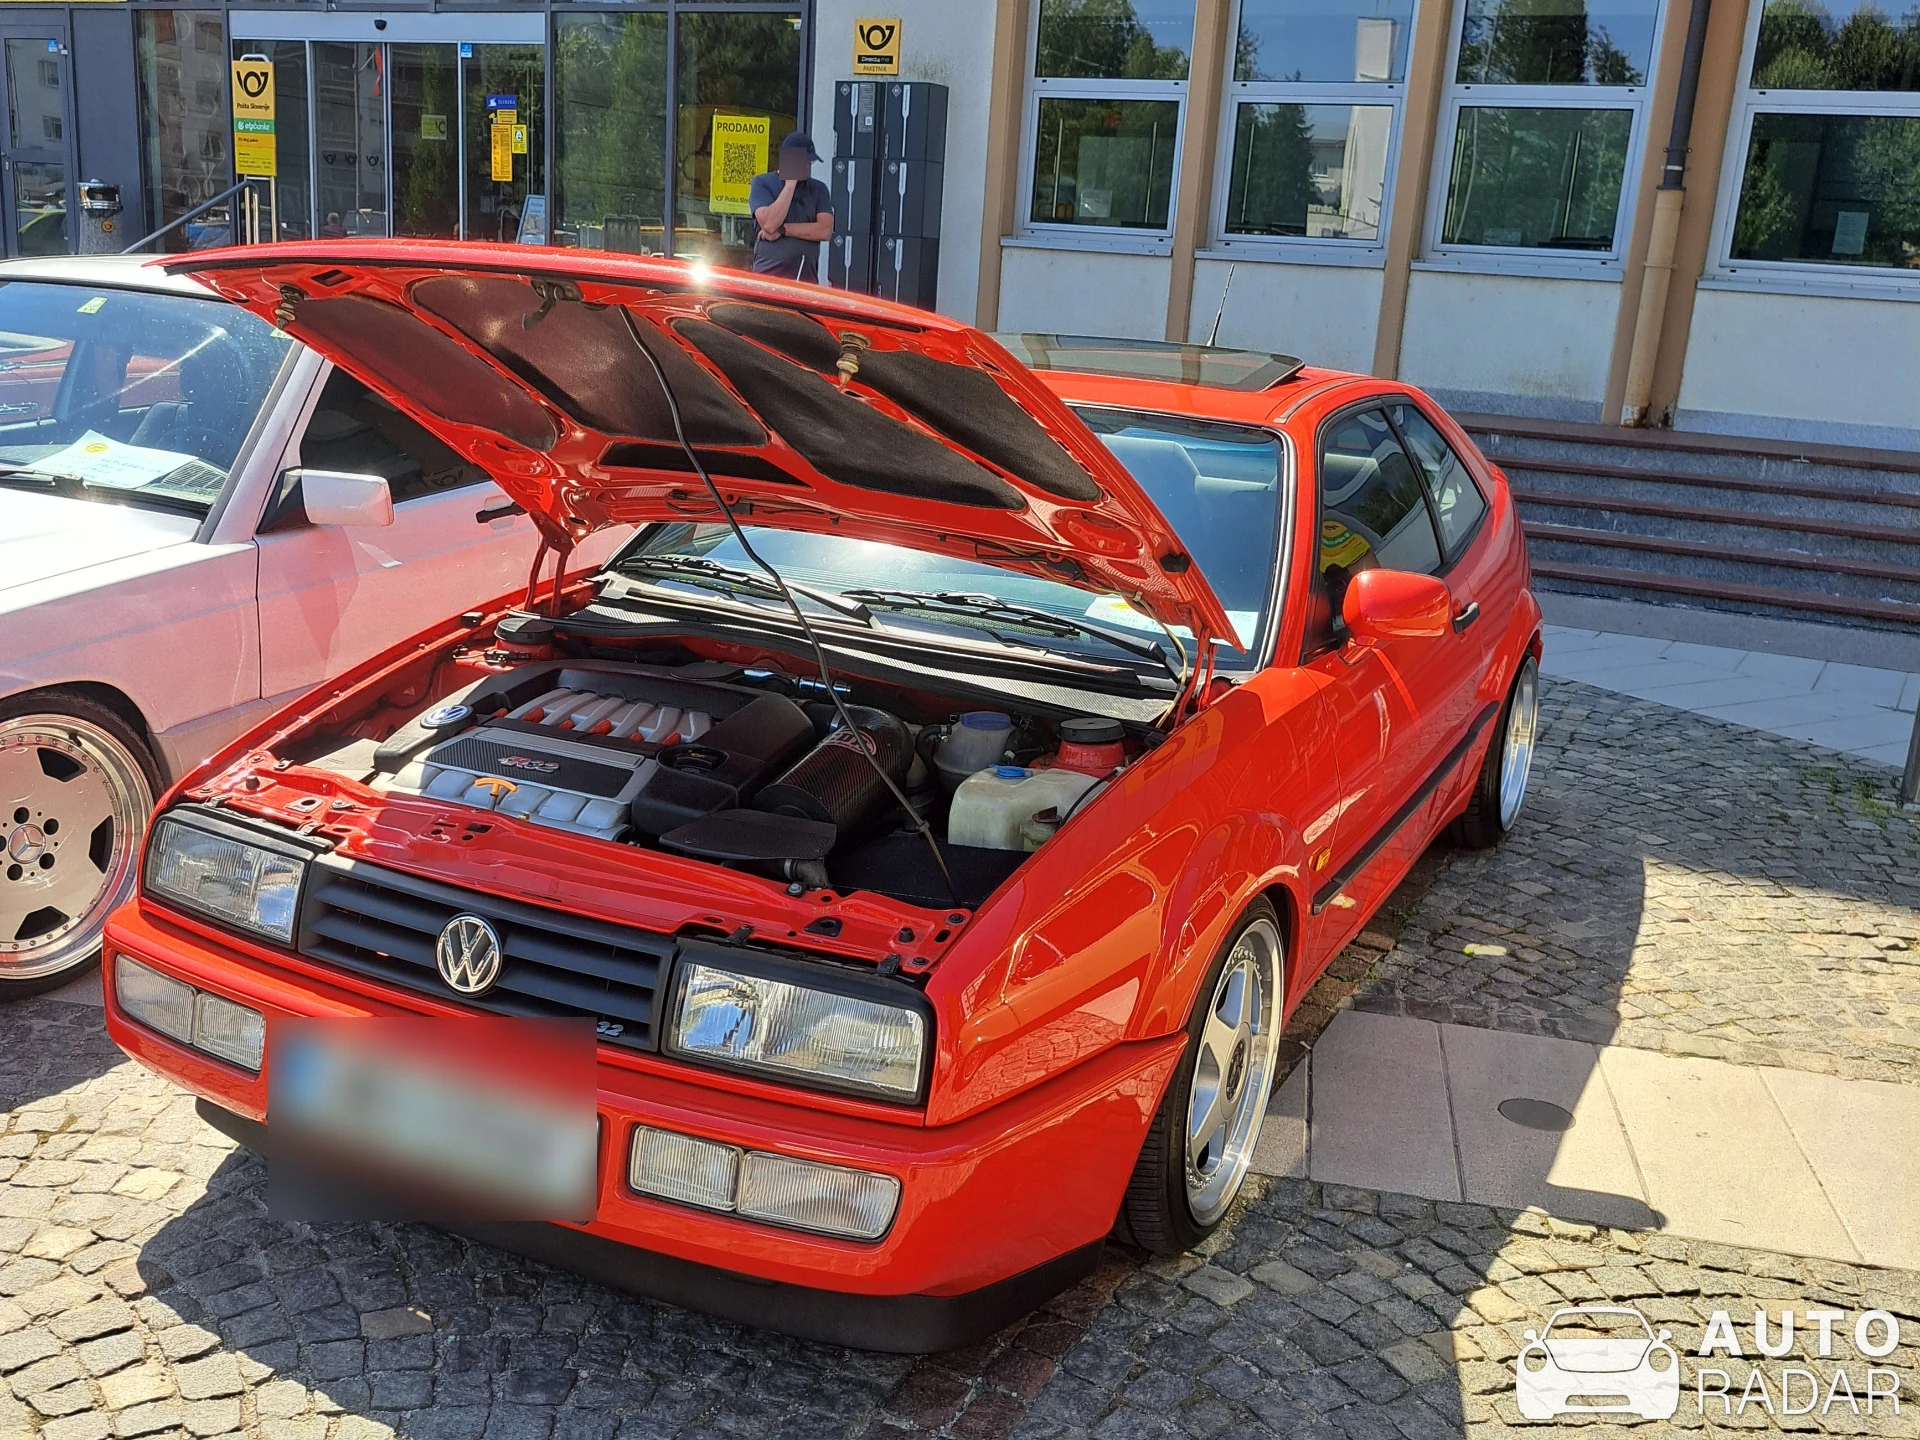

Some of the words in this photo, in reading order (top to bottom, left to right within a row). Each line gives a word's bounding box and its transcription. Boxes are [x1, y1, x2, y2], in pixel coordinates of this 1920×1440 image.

[236, 102, 249, 110] Pošta
[250, 102, 271, 112] Slovenije
[716, 121, 765, 134] PRODAMO
[724, 195, 739, 203] Pošta
